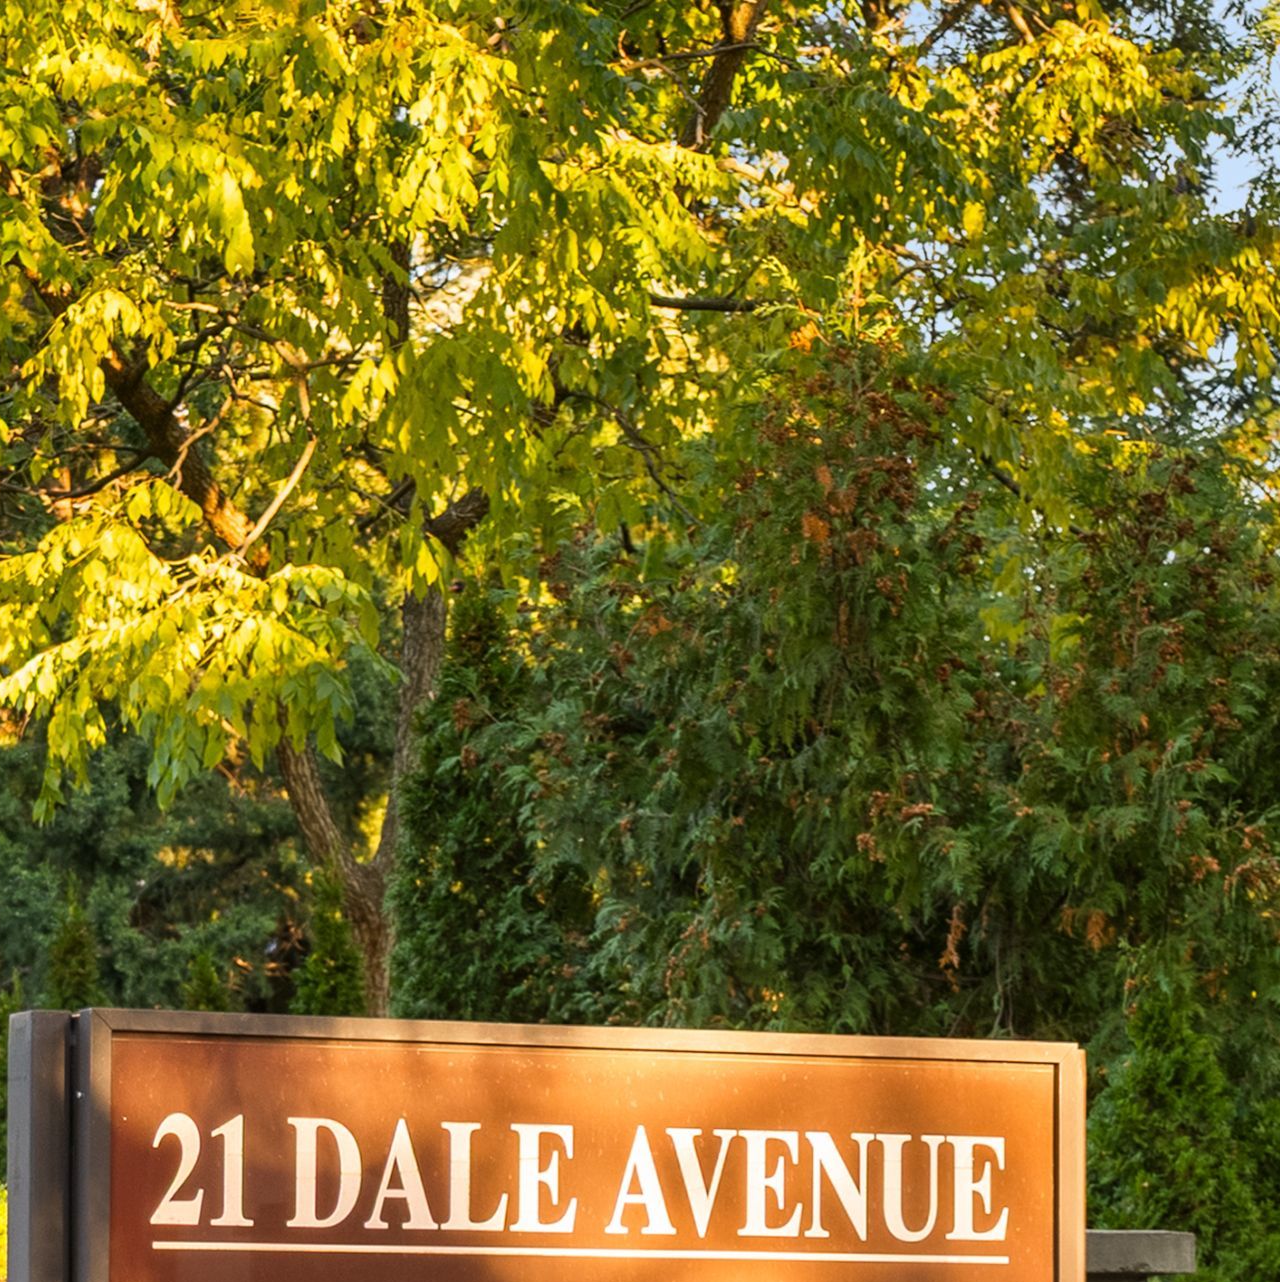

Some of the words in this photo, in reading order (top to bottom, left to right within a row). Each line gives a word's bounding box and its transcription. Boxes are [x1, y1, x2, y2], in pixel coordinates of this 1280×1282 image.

[149, 1111, 255, 1228] 21
[285, 1115, 577, 1235] DALE
[604, 1124, 1010, 1242] AVENUE
